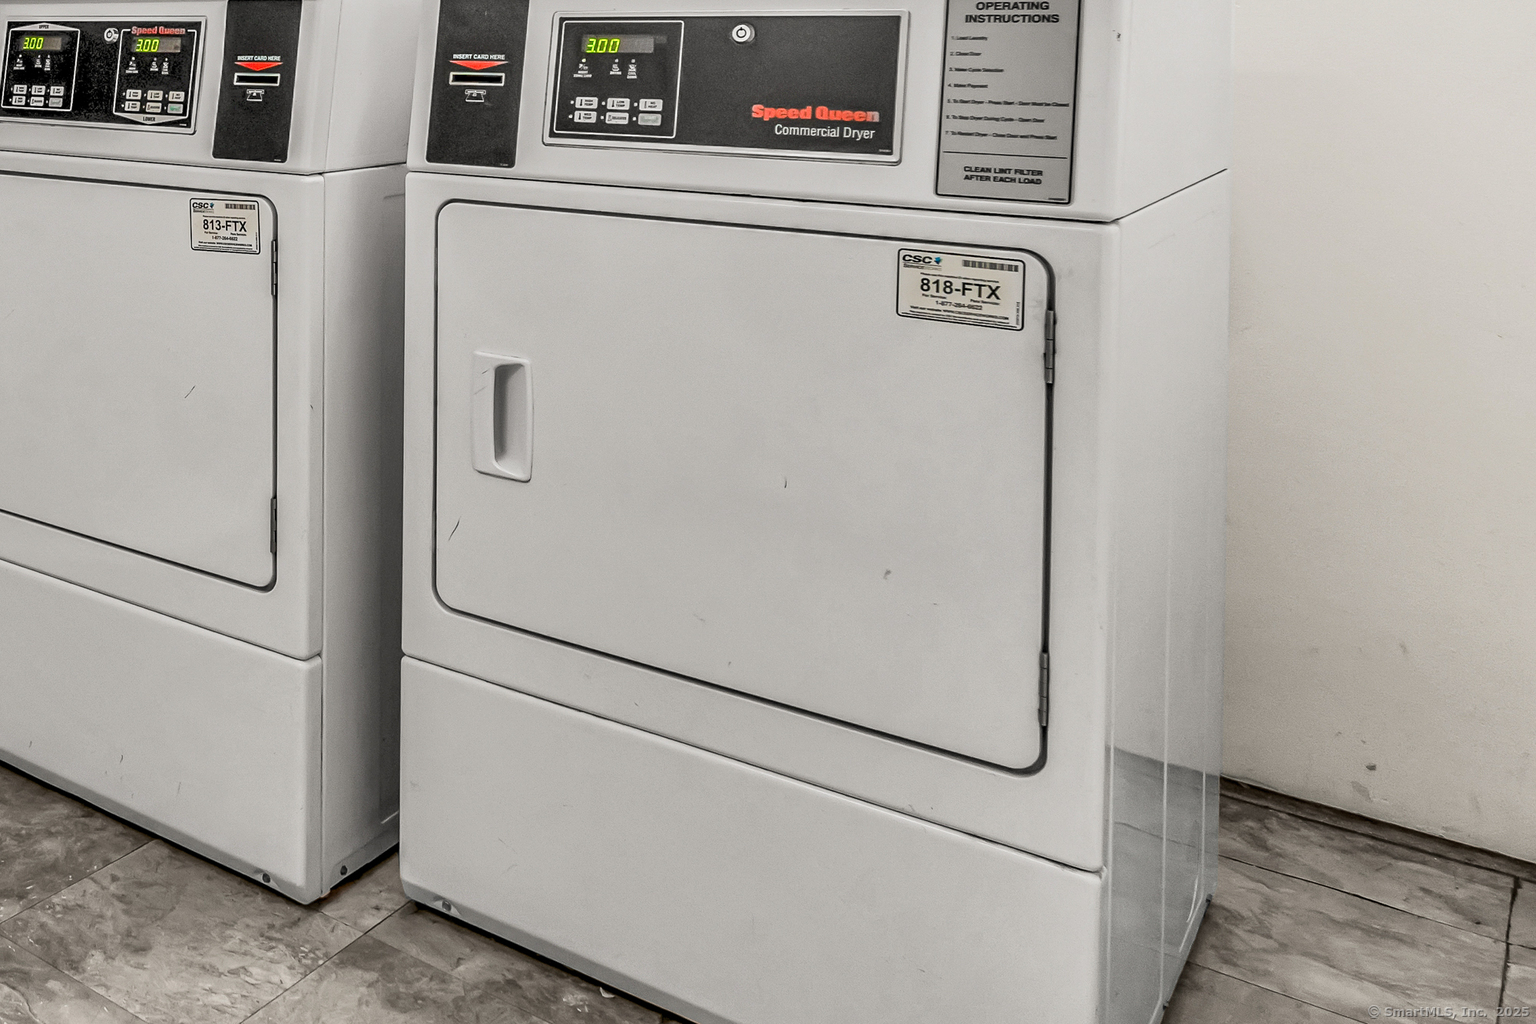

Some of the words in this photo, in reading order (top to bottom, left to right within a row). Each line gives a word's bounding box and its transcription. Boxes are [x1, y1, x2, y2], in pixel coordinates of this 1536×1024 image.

[976, 1, 1050, 11] OPERATING
[965, 14, 1060, 24] INSTRUCTIONS
[131, 26, 158, 36] Speed
[158, 26, 186, 35] Queen
[752, 104, 812, 121] Speed
[815, 106, 880, 122] Queen
[775, 124, 839, 137] Commercial
[843, 126, 875, 141] Dryer
[994, 167, 1013, 175] LINT
[1014, 168, 1043, 176] FILTER
[964, 174, 991, 182] AFTER
[993, 175, 1016, 183] EACH
[1018, 177, 1042, 185] LOAD
[202, 219, 247, 232] 813-FTX
[902, 254, 933, 264] CSC
[920, 277, 1001, 300] 818-FTX
